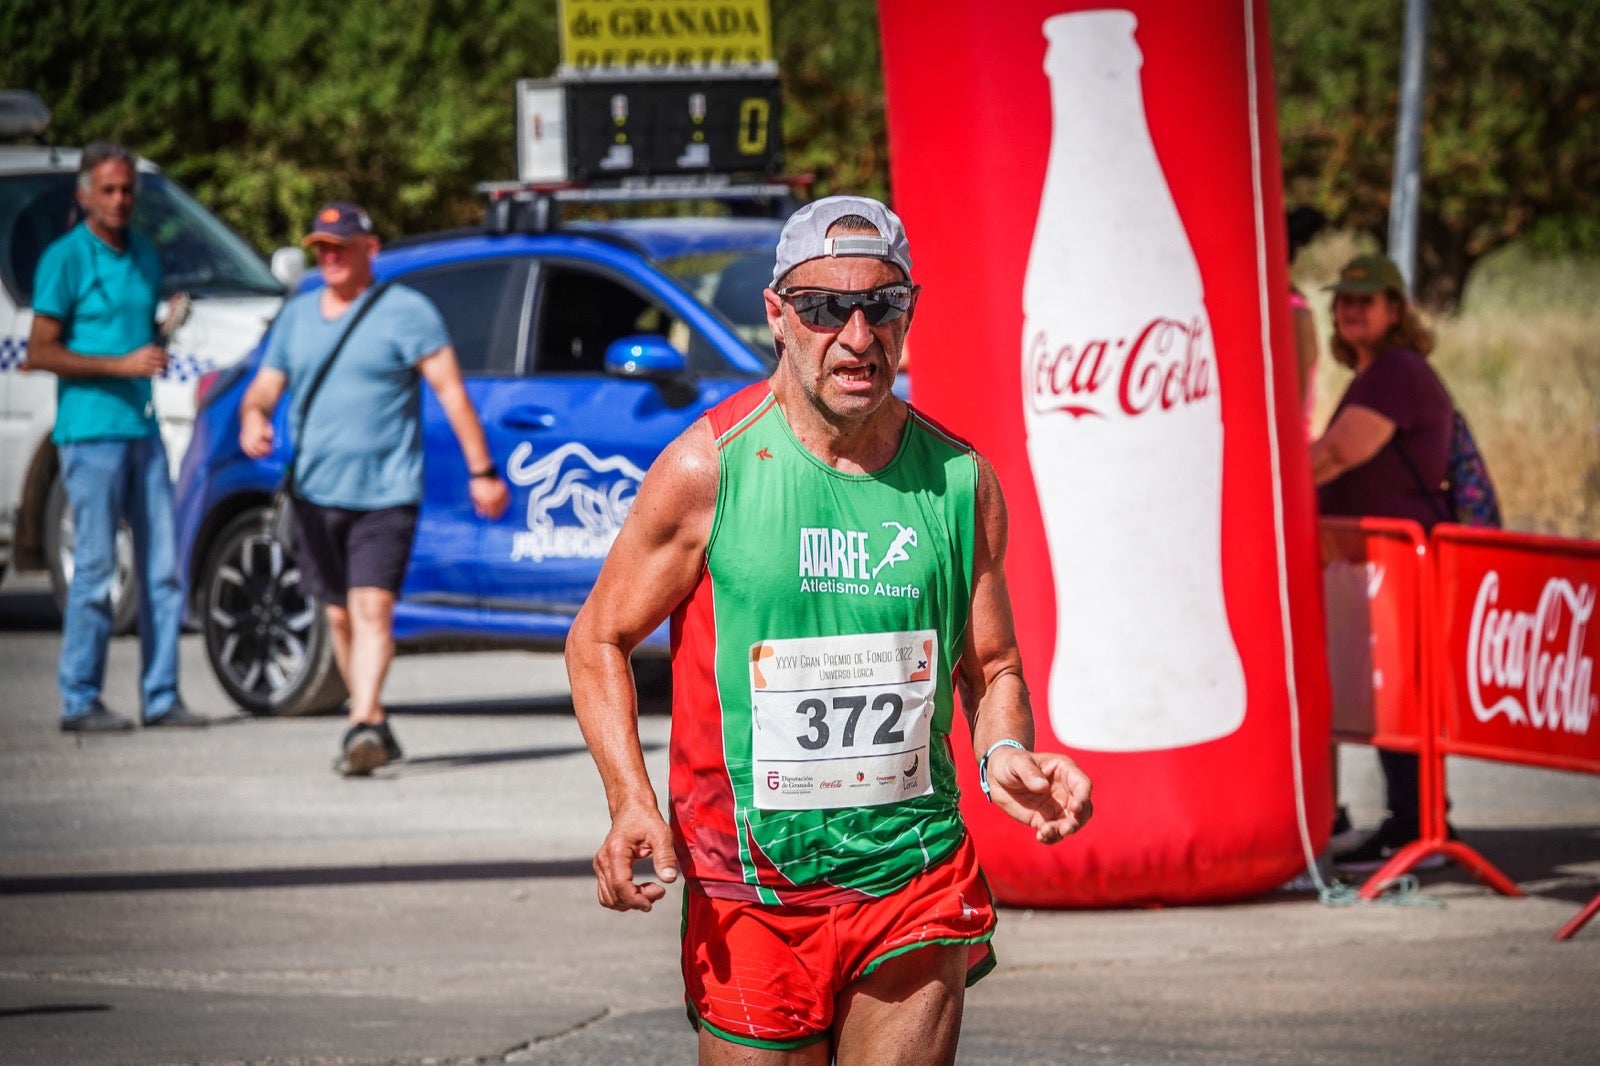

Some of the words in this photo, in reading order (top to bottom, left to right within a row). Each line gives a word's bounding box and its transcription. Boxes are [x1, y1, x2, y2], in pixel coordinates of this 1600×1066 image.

[570, 8, 601, 39] de
[608, 6, 760, 39] GRANADA
[799, 527, 870, 580] ATARFE
[800, 578, 869, 595] Atletismo
[874, 582, 920, 598] Atarfe
[775, 656, 797, 670] XXXV
[895, 646, 913, 662] 2022
[795, 692, 905, 751] 372
[781, 775, 813, 783] Diputación
